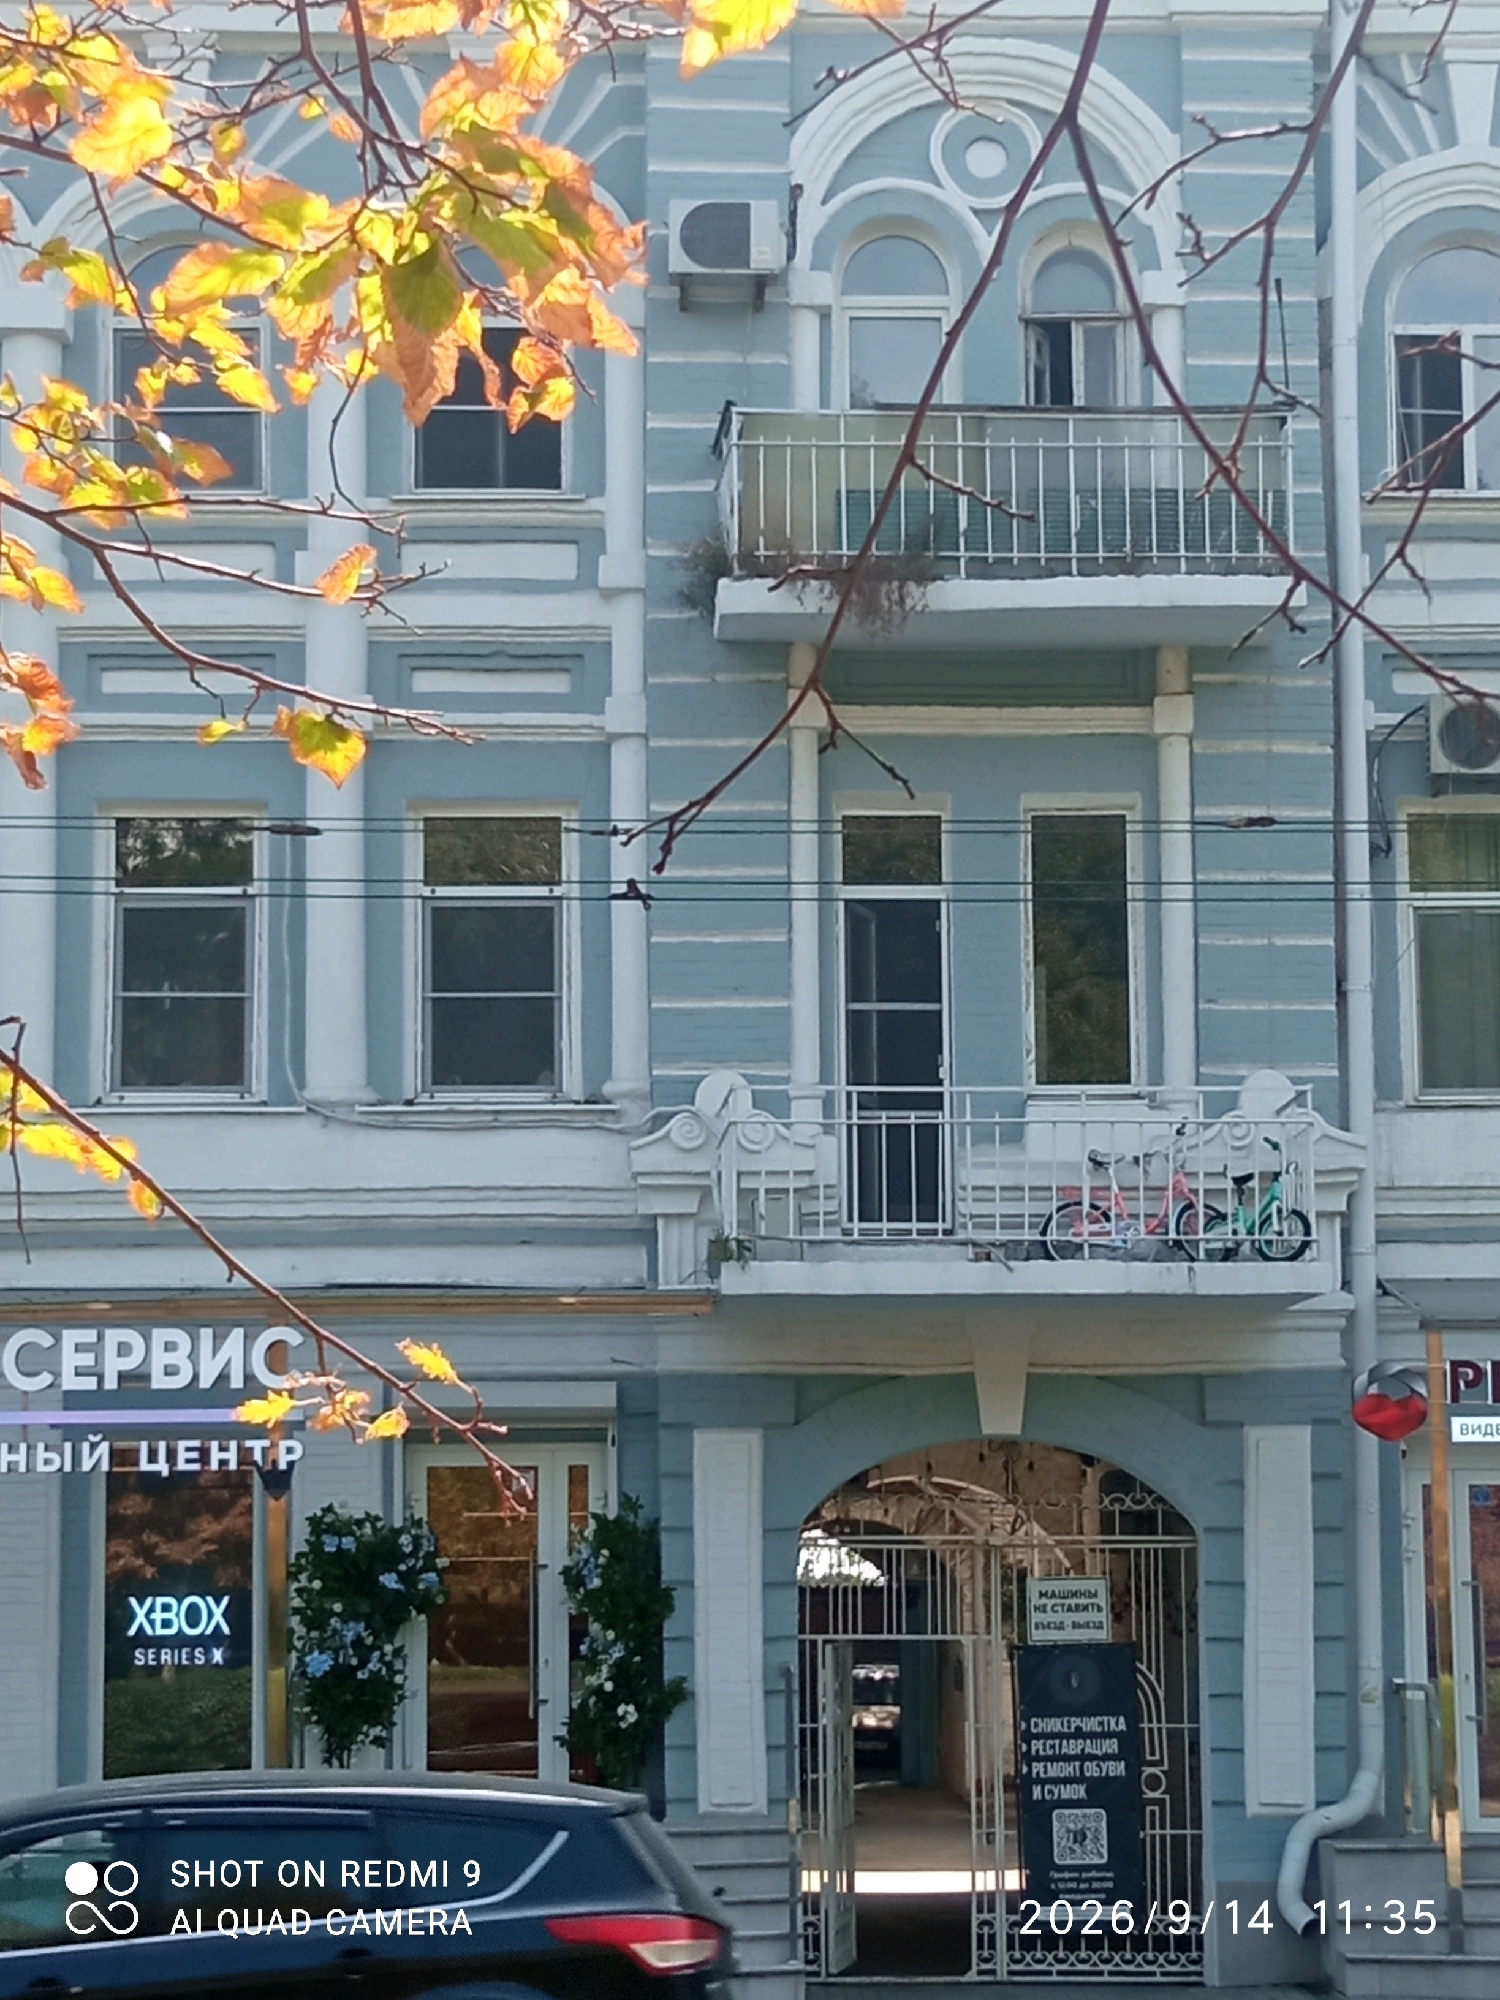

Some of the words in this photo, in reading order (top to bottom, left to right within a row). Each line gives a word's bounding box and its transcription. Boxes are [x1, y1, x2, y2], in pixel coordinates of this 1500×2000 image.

[2, 1327, 306, 1391] СЕРВИС
[0, 1434, 111, 1473] НЫЙ
[139, 1440, 304, 1478] ЦЕНТР
[1038, 1588, 1098, 1600] МАШИНЫ
[127, 1595, 231, 1637] XBOX
[1033, 1603, 1049, 1614] НЕ
[1050, 1602, 1105, 1614] СТАВИТЬ
[134, 1647, 206, 1666] SERIES
[211, 1647, 225, 1665] X
[1030, 1716, 1127, 1733] СНИКЕРЧИСТКА
[1031, 1738, 1119, 1756] РЕСТАВРАЦИЯ
[1031, 1761, 1081, 1778] РЕМОНТ
[1084, 1760, 1126, 1777] ОБУВИ
[1032, 1784, 1042, 1801] И
[1044, 1783, 1087, 1800] СУМОК
